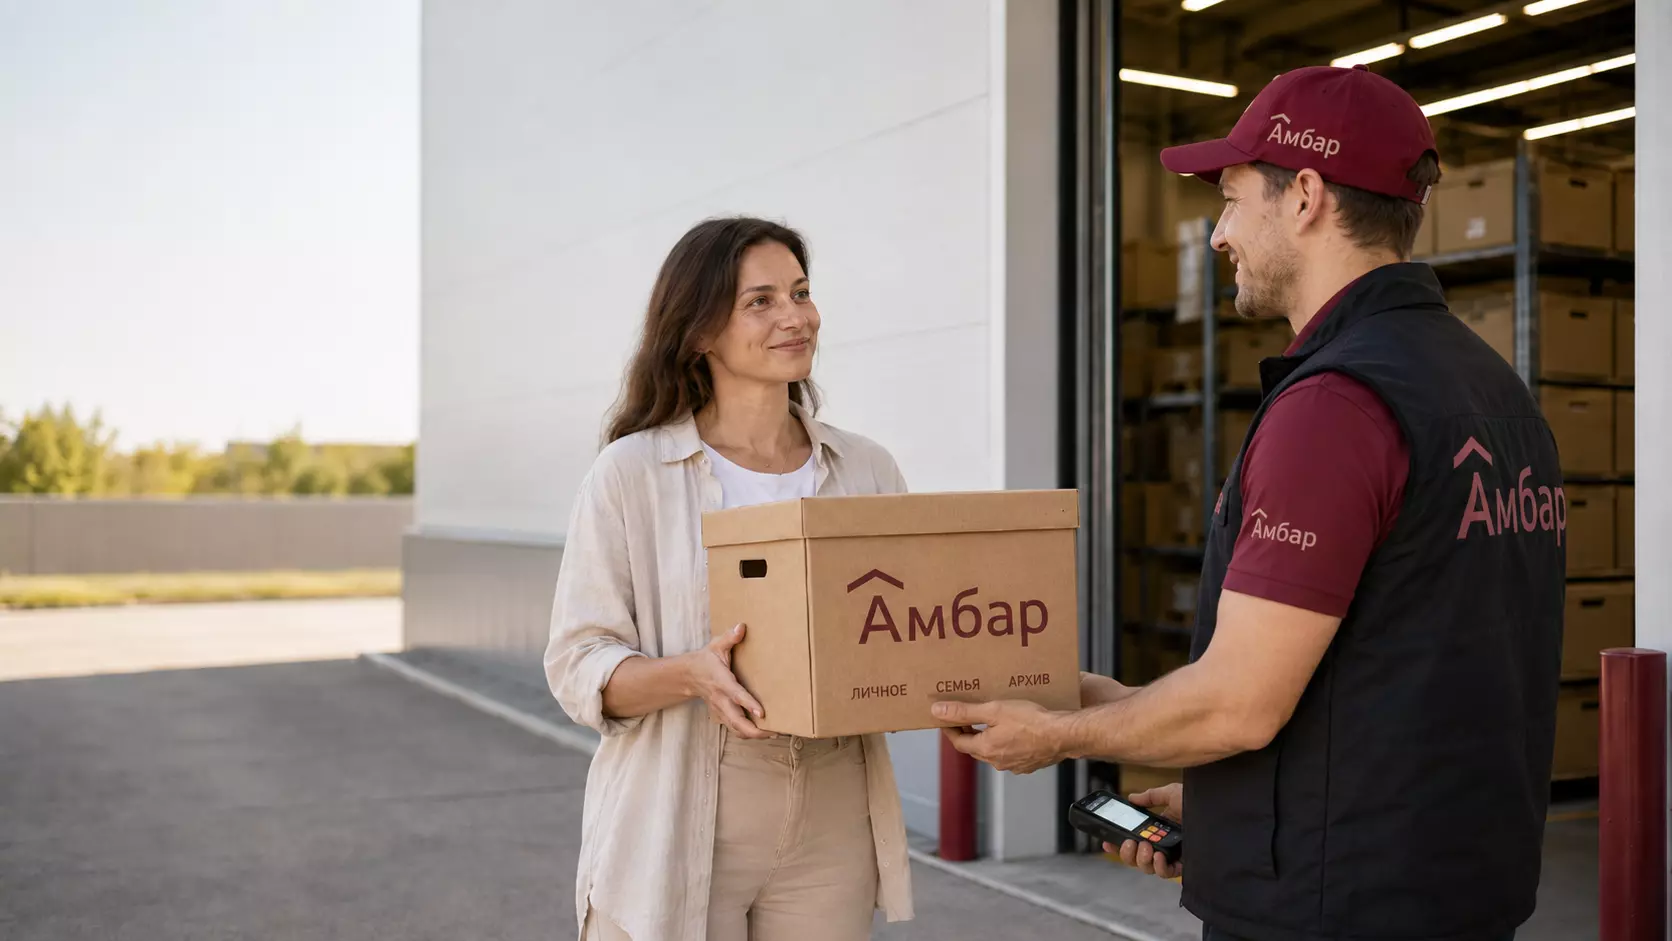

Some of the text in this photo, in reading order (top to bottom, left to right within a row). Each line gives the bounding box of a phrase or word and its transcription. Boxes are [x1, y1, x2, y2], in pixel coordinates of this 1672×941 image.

[1267, 122, 1340, 158] Амбар
[1456, 466, 1566, 546] Амбар
[1251, 517, 1317, 550] Амбар
[858, 587, 1048, 647] Амбар
[851, 673, 1050, 700] ЛИЧНОЕ СЕМЬЯ АРХИВ
